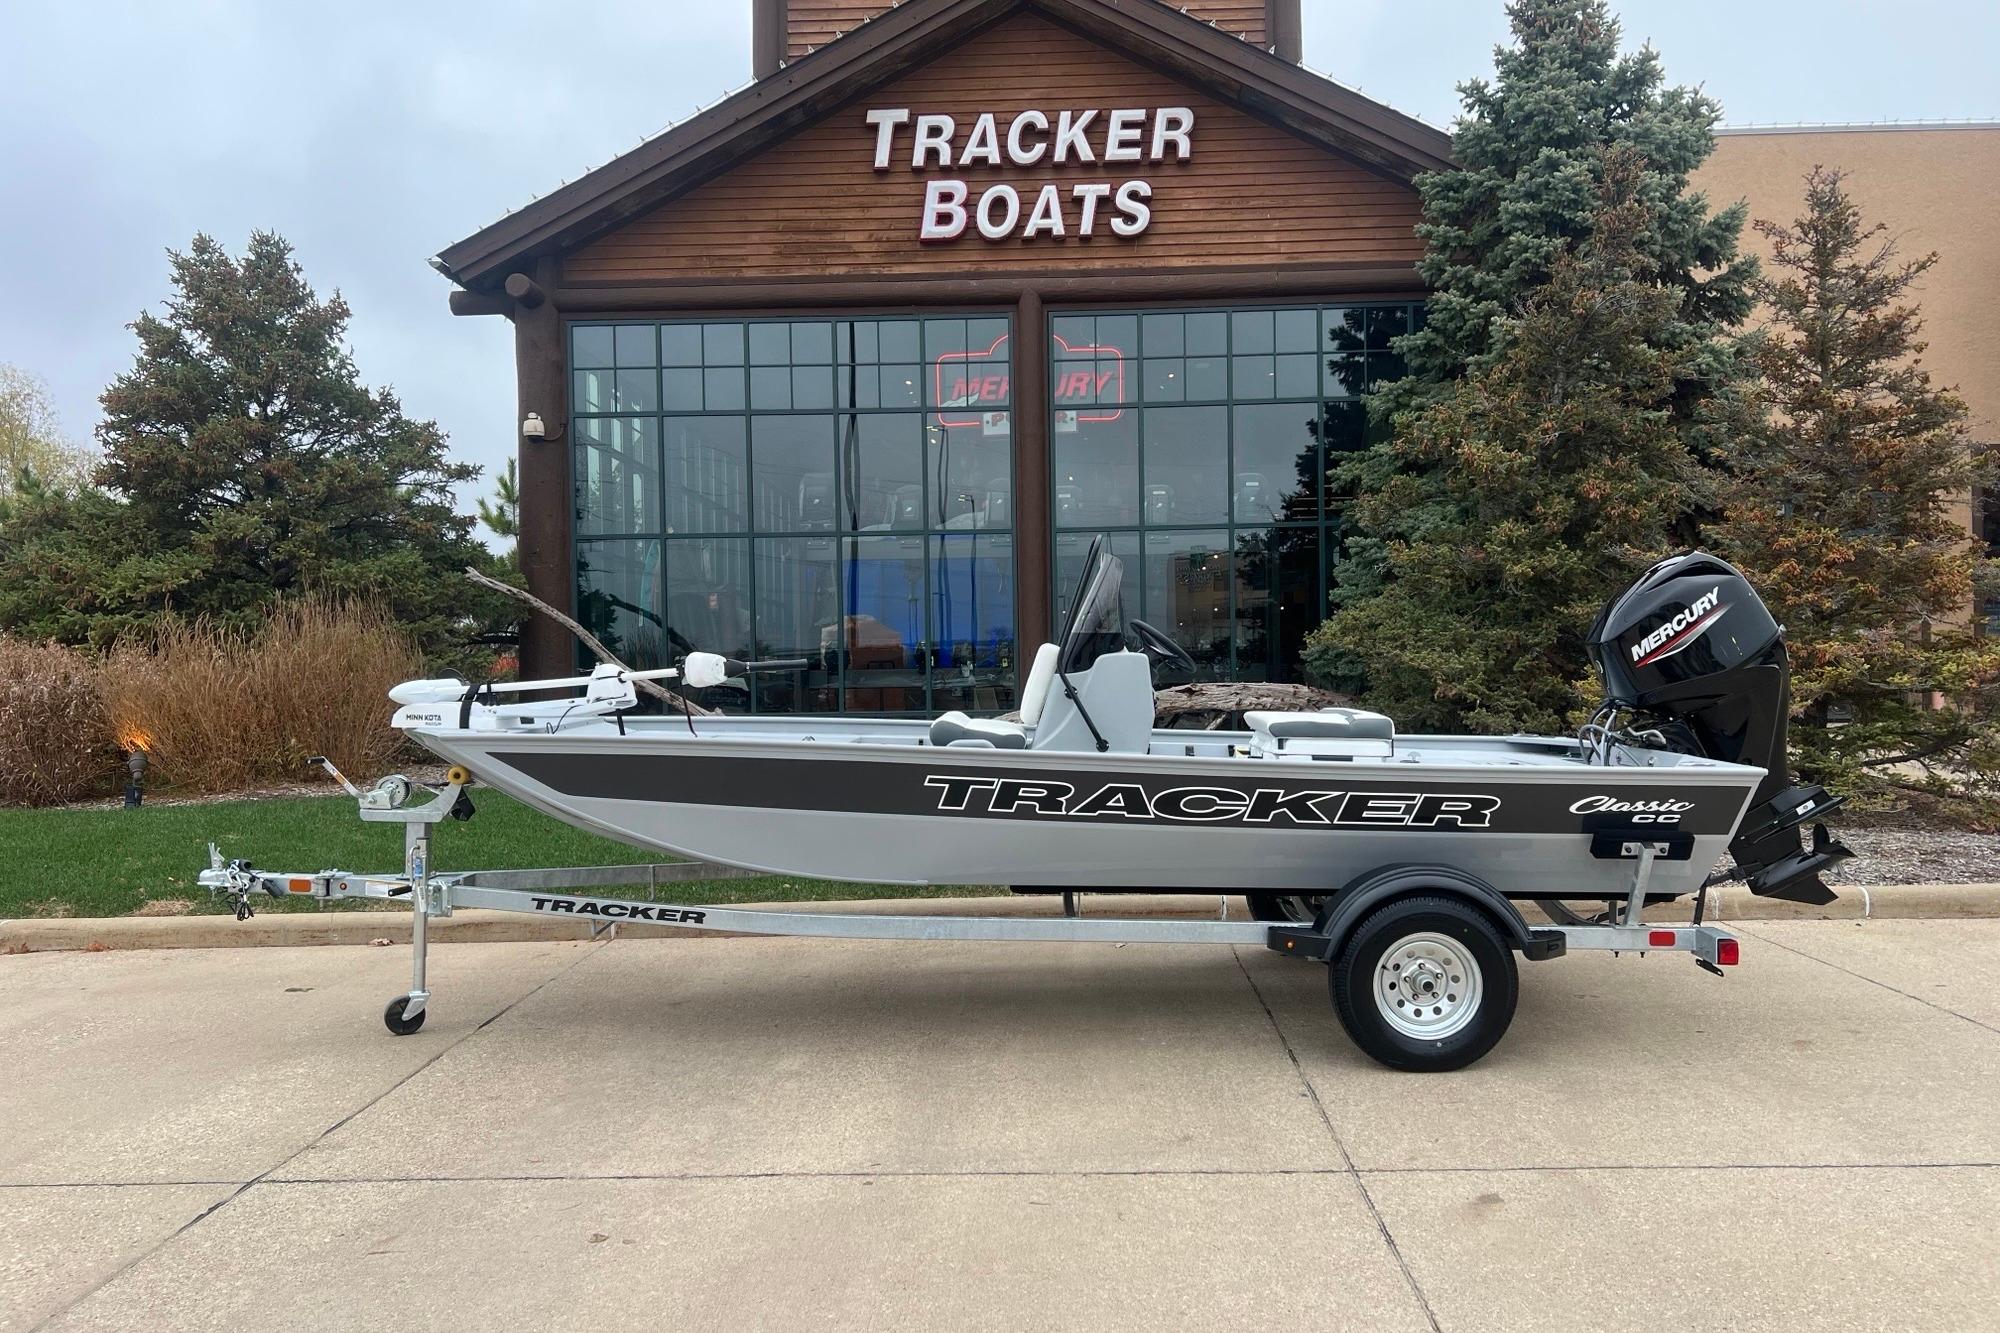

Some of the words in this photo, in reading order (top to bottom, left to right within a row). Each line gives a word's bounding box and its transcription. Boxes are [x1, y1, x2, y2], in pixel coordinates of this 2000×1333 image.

[865, 106, 1196, 171] TRACKER
[919, 179, 1153, 242] BOATS
[1630, 585, 1719, 662] MERCURY
[923, 775, 1502, 828] TRACKER
[1569, 795, 1696, 815] Classic
[1631, 814, 1682, 823] CC
[531, 897, 707, 925] TRACKER
